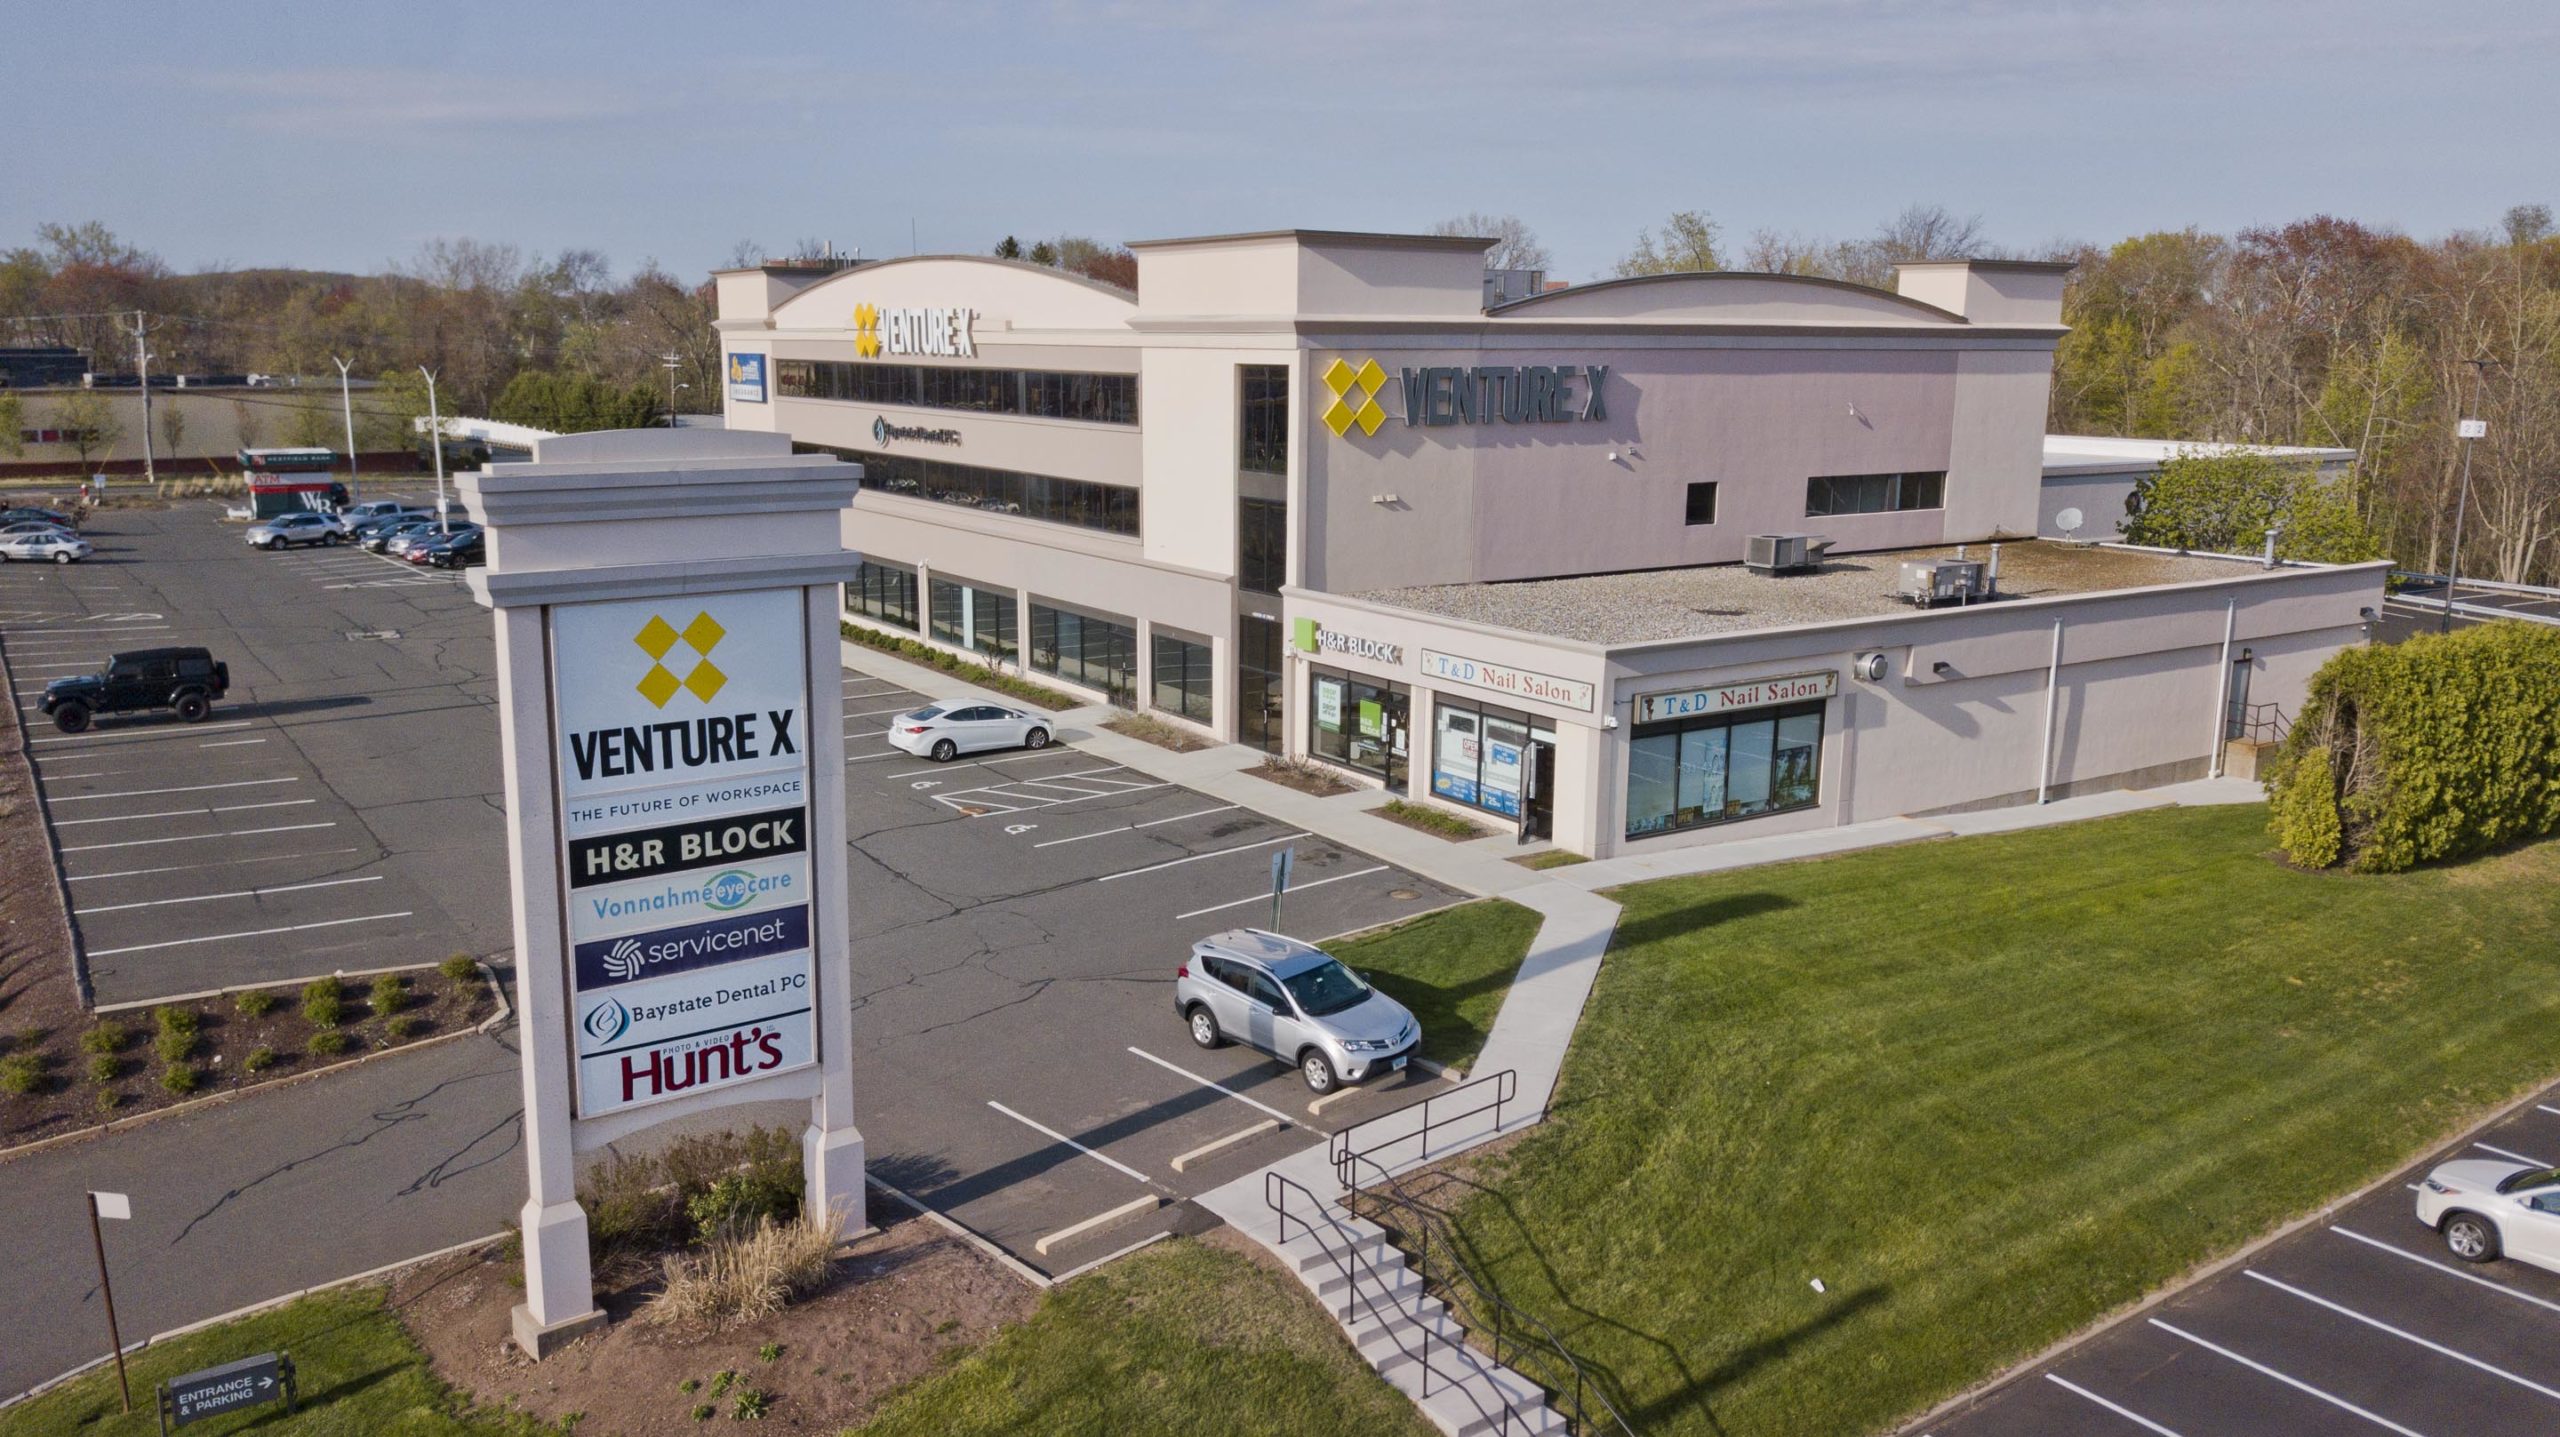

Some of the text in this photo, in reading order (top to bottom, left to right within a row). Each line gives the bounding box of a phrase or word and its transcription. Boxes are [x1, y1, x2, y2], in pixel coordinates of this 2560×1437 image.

[880, 308, 972, 356] VENTURE X
[1400, 365, 1609, 426] VENTURE X
[255, 473, 280, 484] ATM
[1318, 630, 1393, 661] H&R BLOCK
[1438, 657, 1572, 702] T & D Nail Salon
[1664, 681, 1818, 715] T & D Nail Salon
[570, 709, 797, 781] VENTURE X
[572, 780, 802, 823] THE FUTURE OF WORKSPACE
[586, 818, 796, 876] H&R BLOCK
[648, 918, 785, 964] servicenet
[632, 973, 807, 1022] Baystate Dental PC
[621, 1026, 783, 1102] Hunt's
[663, 1043, 691, 1055] PHOTO
[703, 1034, 730, 1046] VIDEO
[179, 1376, 253, 1405] ENTRANCE
[180, 1388, 254, 1416] & PARKING
